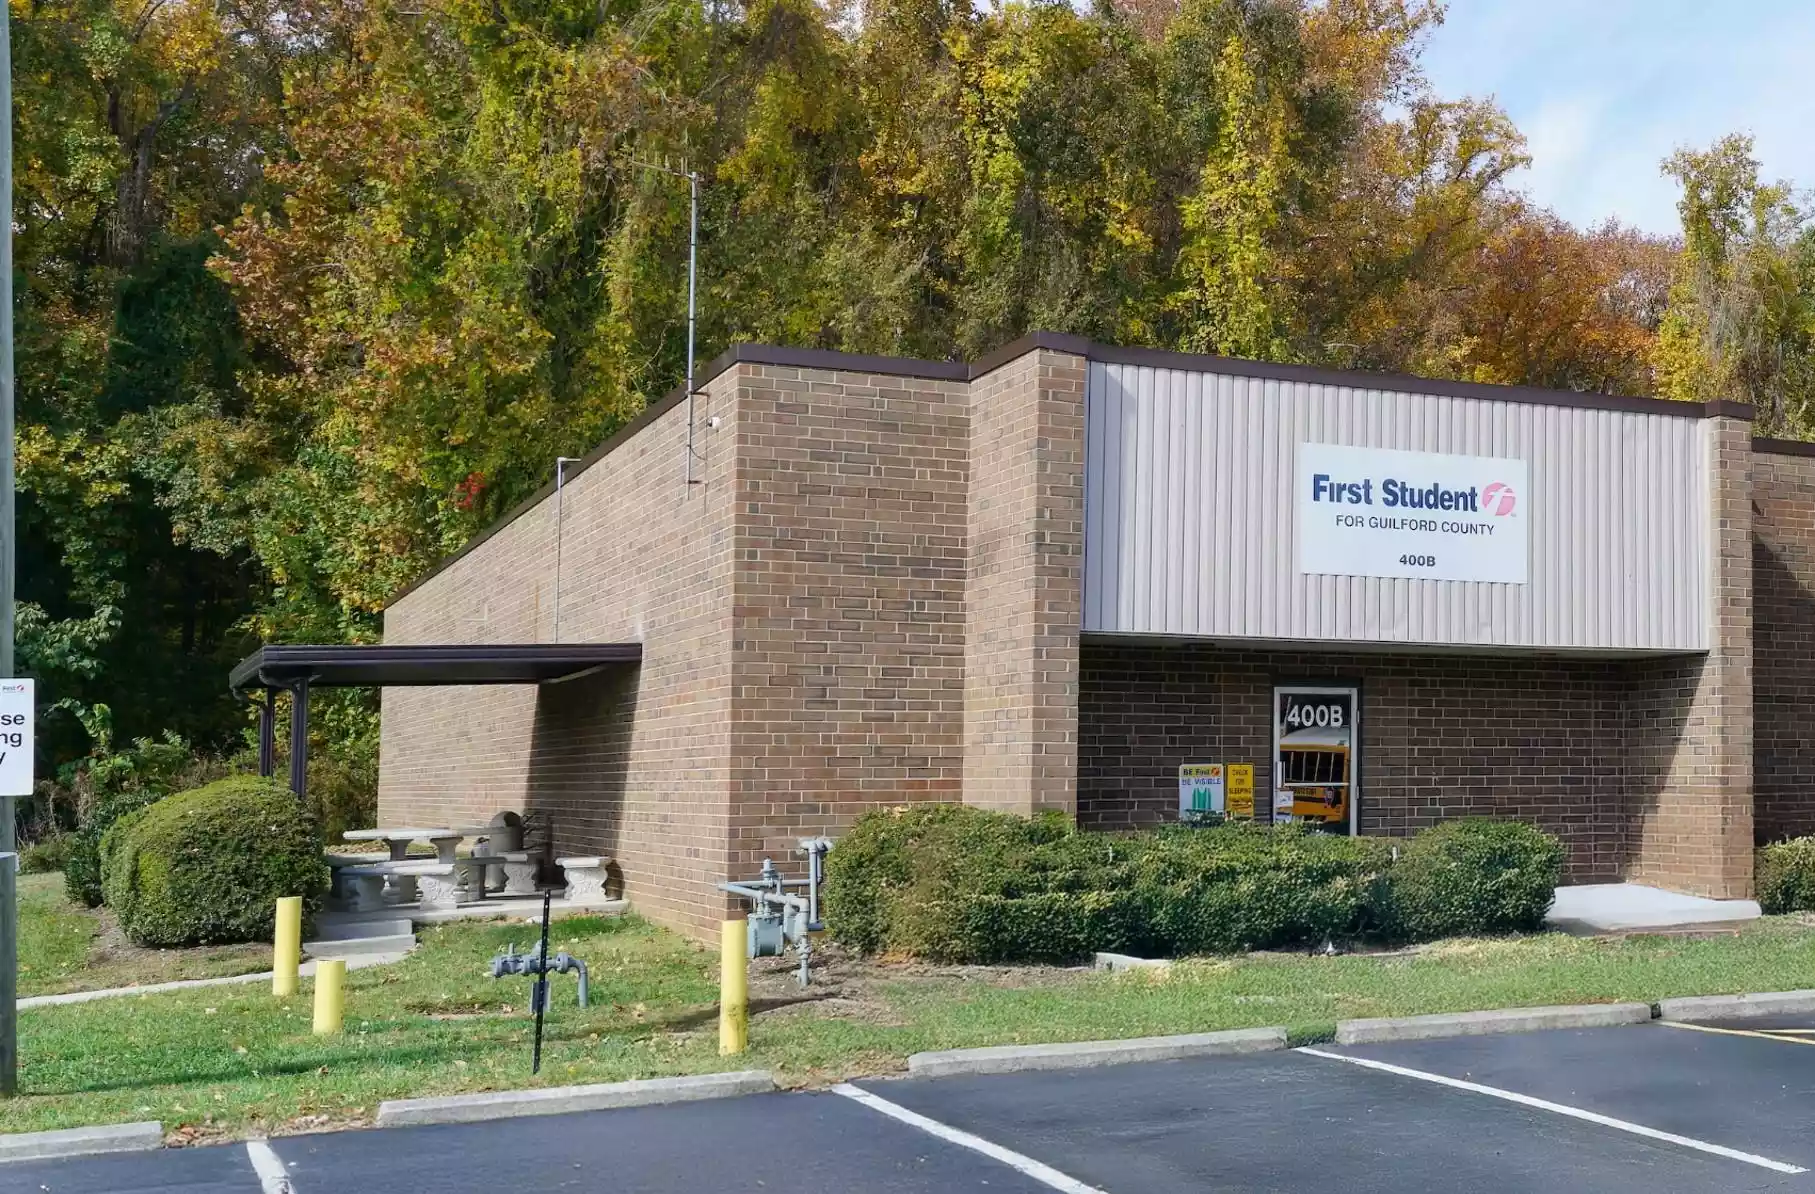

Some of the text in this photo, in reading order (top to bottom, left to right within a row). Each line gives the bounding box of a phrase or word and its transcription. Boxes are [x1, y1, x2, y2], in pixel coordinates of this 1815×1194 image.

[1313, 473, 1478, 512] First Student
[1335, 514, 1495, 536] FOR GUILFORD COUNTY
[1399, 554, 1436, 567] 400B
[1287, 704, 1343, 727] 400B
[1194, 777, 1222, 785] VISIBLE
